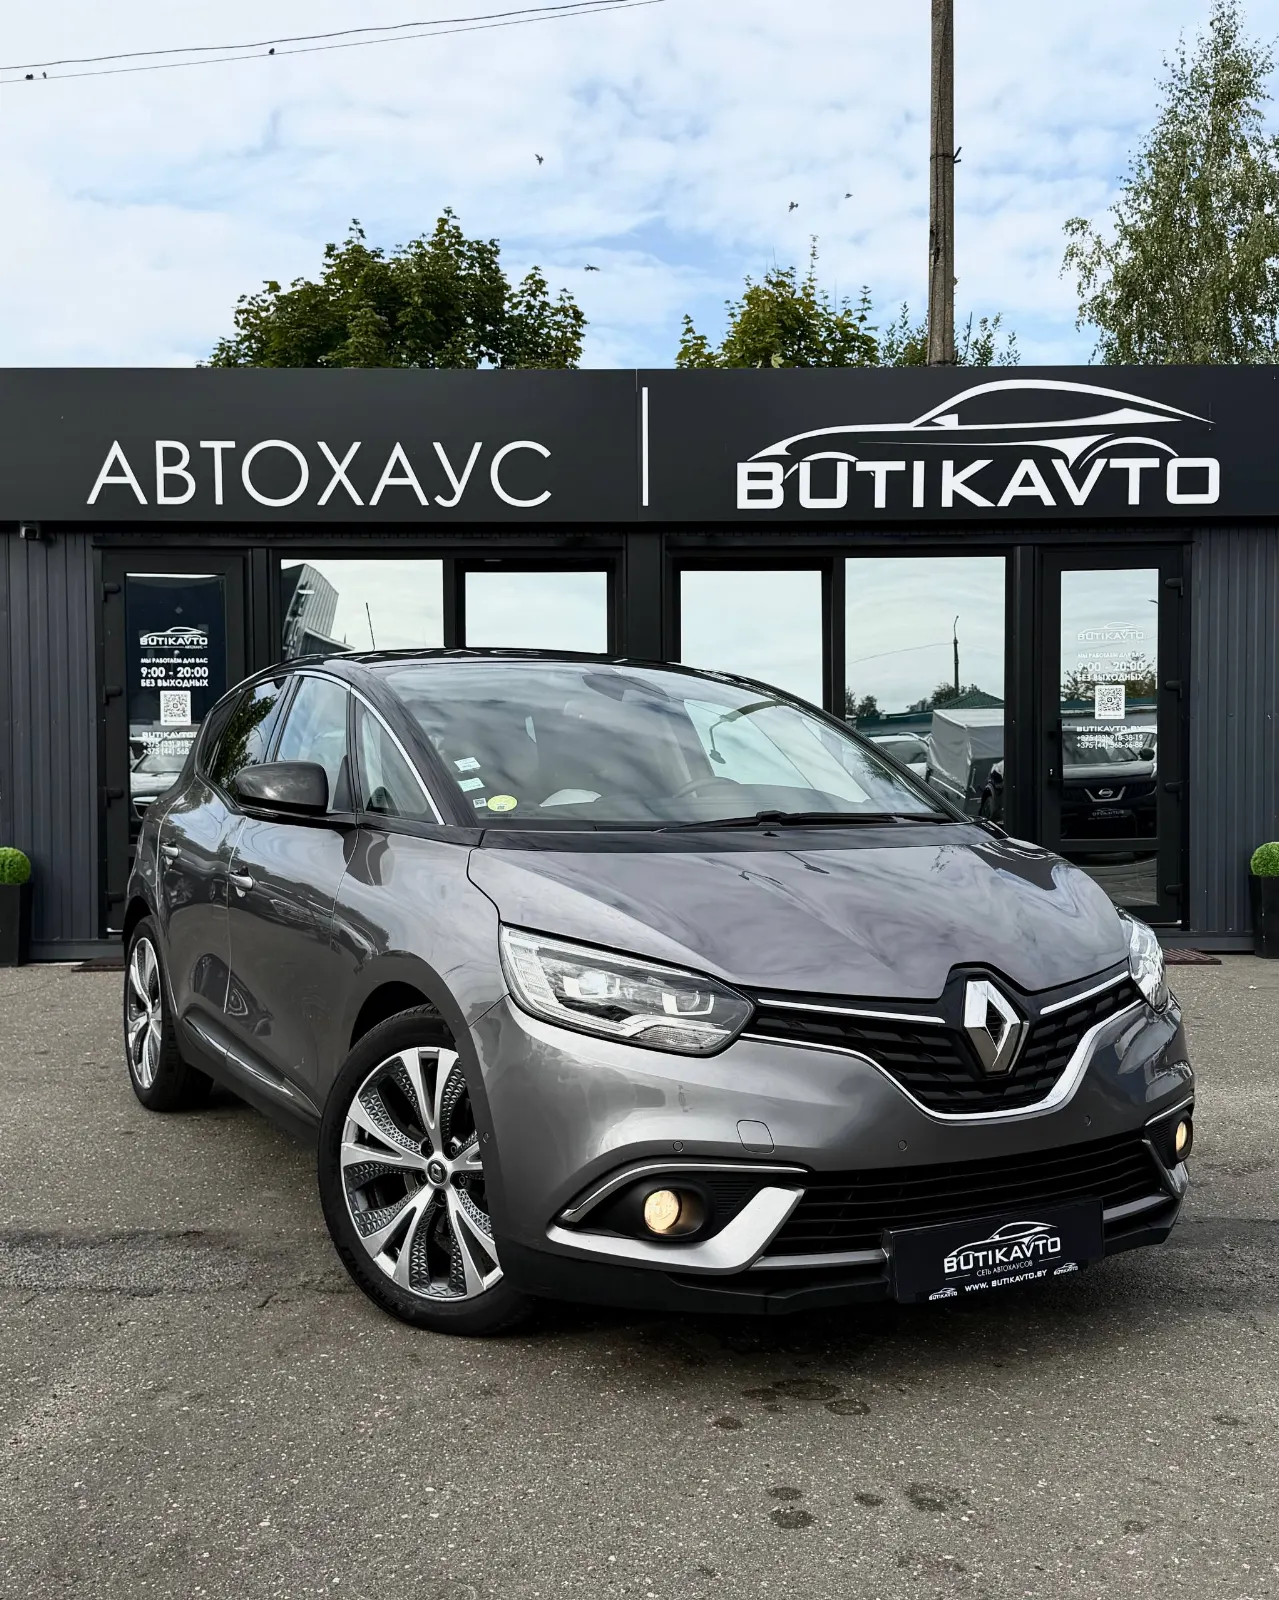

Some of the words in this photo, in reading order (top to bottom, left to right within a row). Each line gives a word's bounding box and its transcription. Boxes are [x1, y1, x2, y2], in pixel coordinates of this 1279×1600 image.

[86, 439, 552, 508] АВТОХАУС
[736, 457, 1221, 510] BUTIKAVTO
[139, 637, 208, 645] BUTIKAVTO
[1077, 632, 1144, 640] BUTIKAVTO
[1077, 661, 1101, 671] 9:00
[1113, 661, 1144, 671] 20:00
[141, 667, 165, 677] 9:00
[177, 667, 208, 677] 20:00
[141, 679, 155, 687] БЕЗ
[157, 679, 208, 687] ВЫХОДНЫХ
[944, 1237, 1061, 1274] BUTIKAVTO
[977, 1268, 992, 1277] СЕТЬ
[991, 1269, 1048, 1287] BUTIKAVTO.BY
